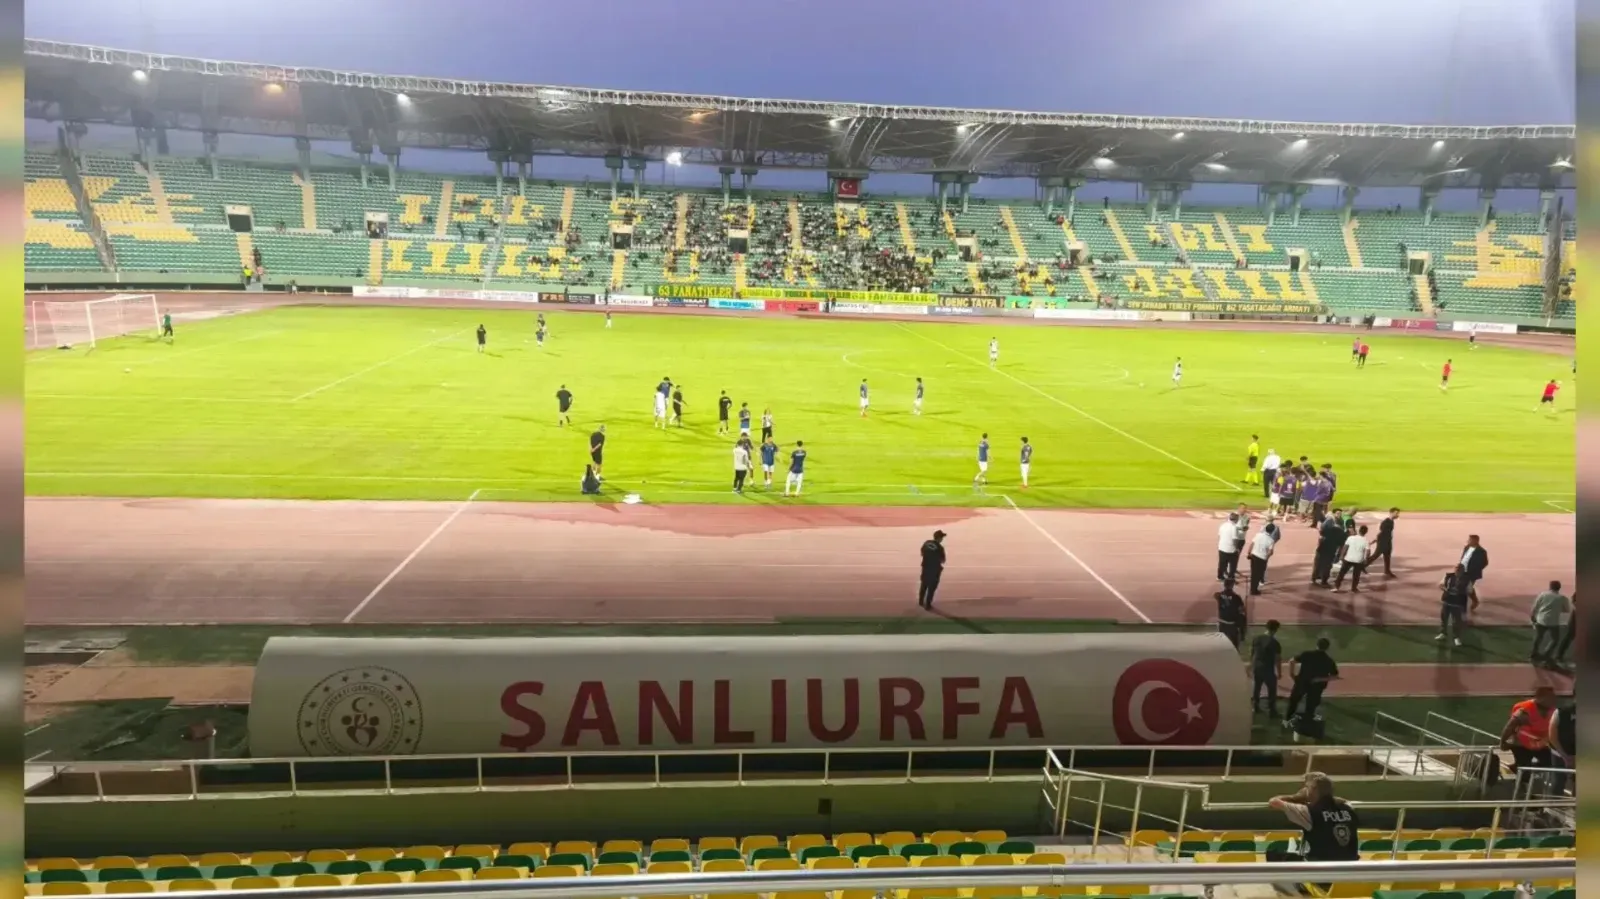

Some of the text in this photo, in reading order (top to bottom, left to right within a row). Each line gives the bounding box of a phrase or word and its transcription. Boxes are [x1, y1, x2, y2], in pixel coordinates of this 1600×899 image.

[658, 286, 670, 297] 63
[971, 297, 997, 309] TAYFA
[499, 676, 1045, 753] ŞANLIURFA
